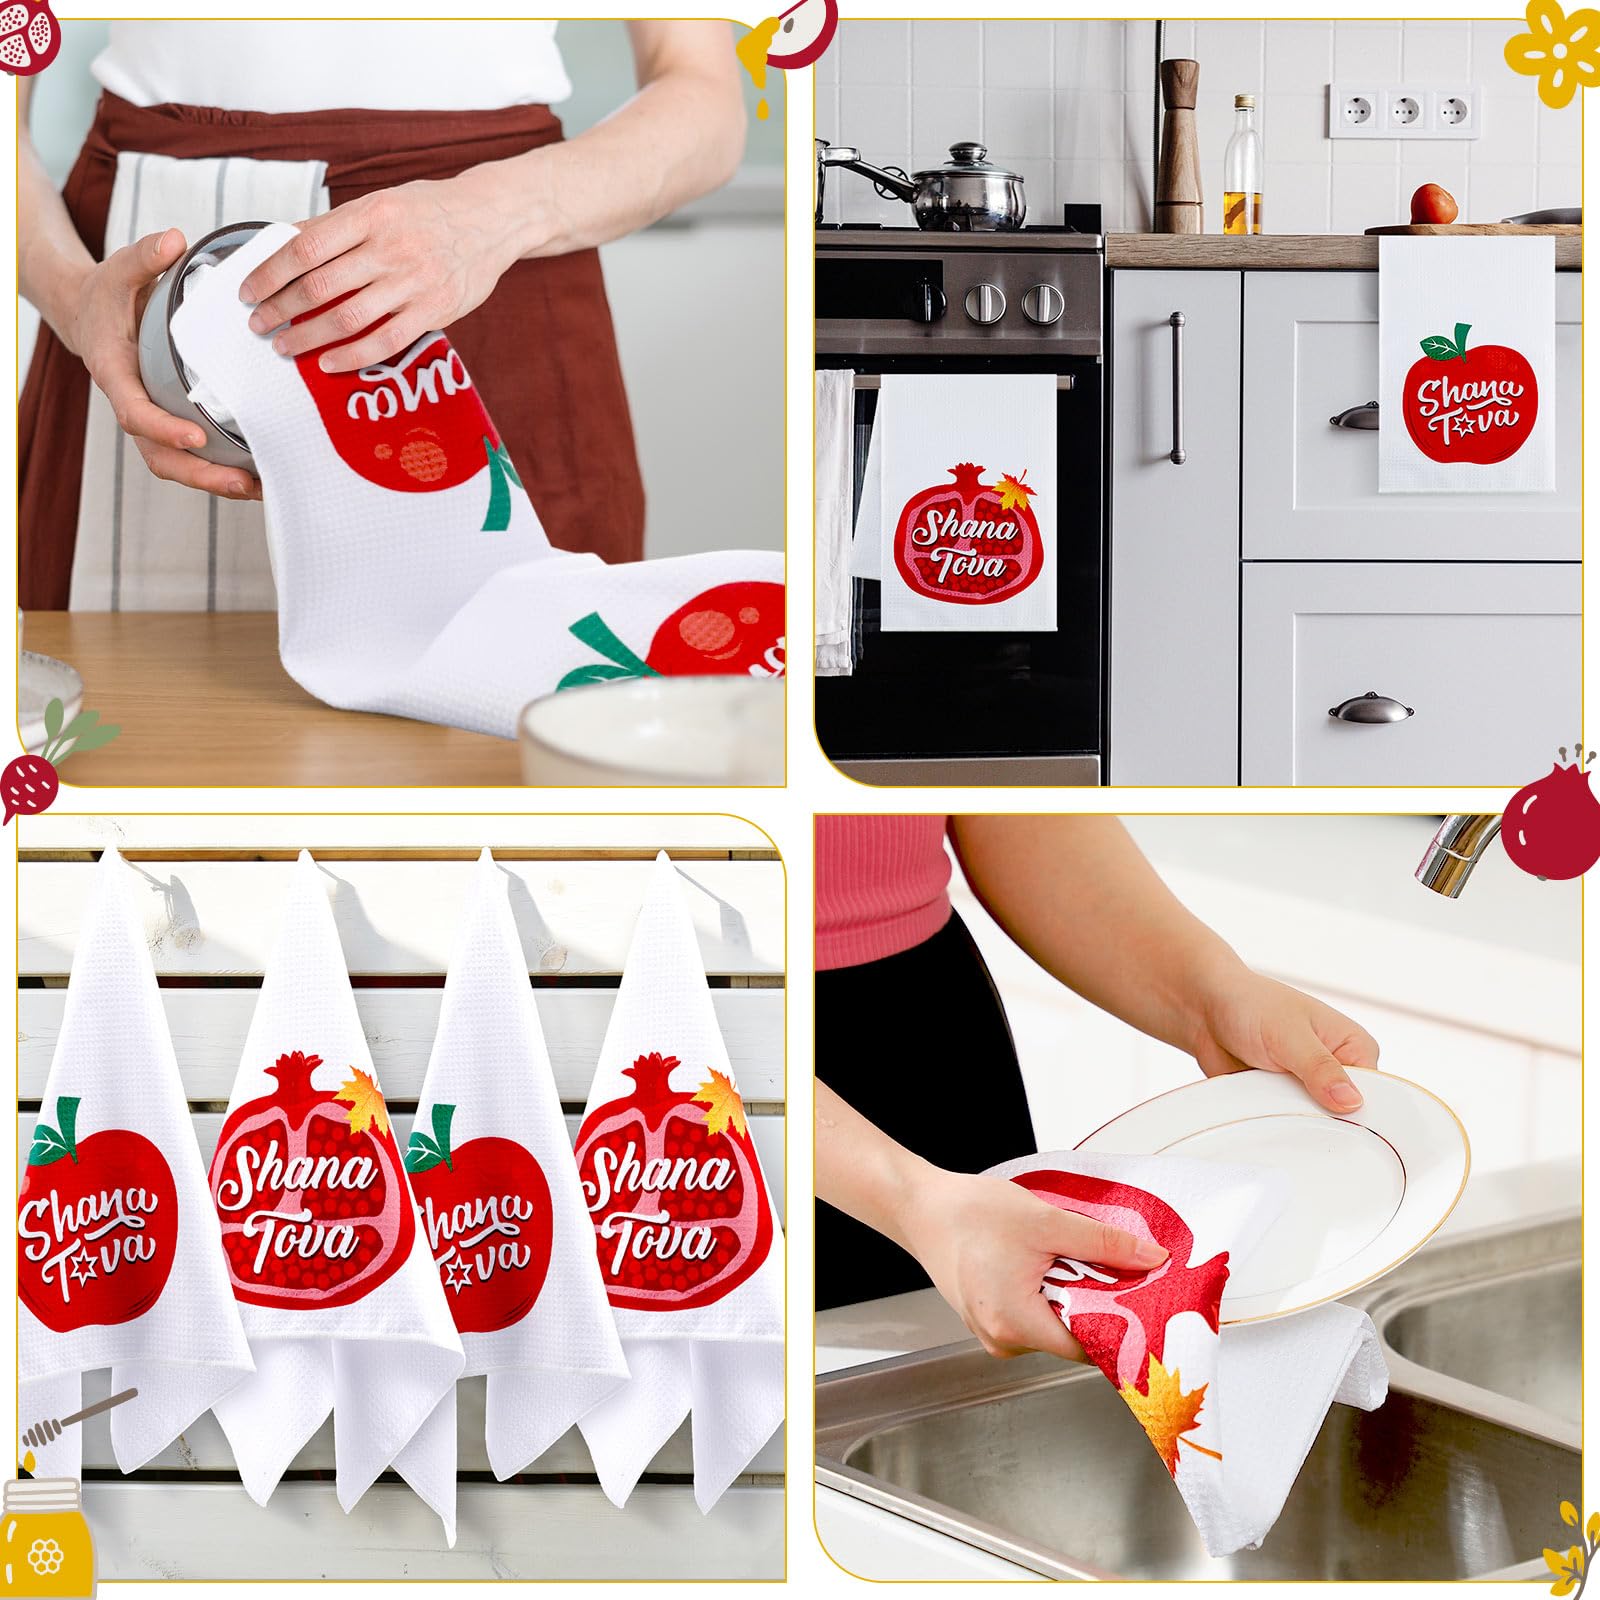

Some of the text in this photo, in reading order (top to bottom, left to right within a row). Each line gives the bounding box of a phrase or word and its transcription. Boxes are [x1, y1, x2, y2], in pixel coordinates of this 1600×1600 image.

[1417, 375, 1524, 416] Shana
[912, 508, 1019, 546] Shana
[930, 547, 1007, 584] Tova
[217, 1140, 378, 1211] Shana
[582, 1141, 736, 1212] Shana
[18, 1187, 158, 1261] Shana
[243, 1208, 360, 1274] Tova
[417, 1195, 533, 1250] hana
[601, 1209, 717, 1276] Tova
